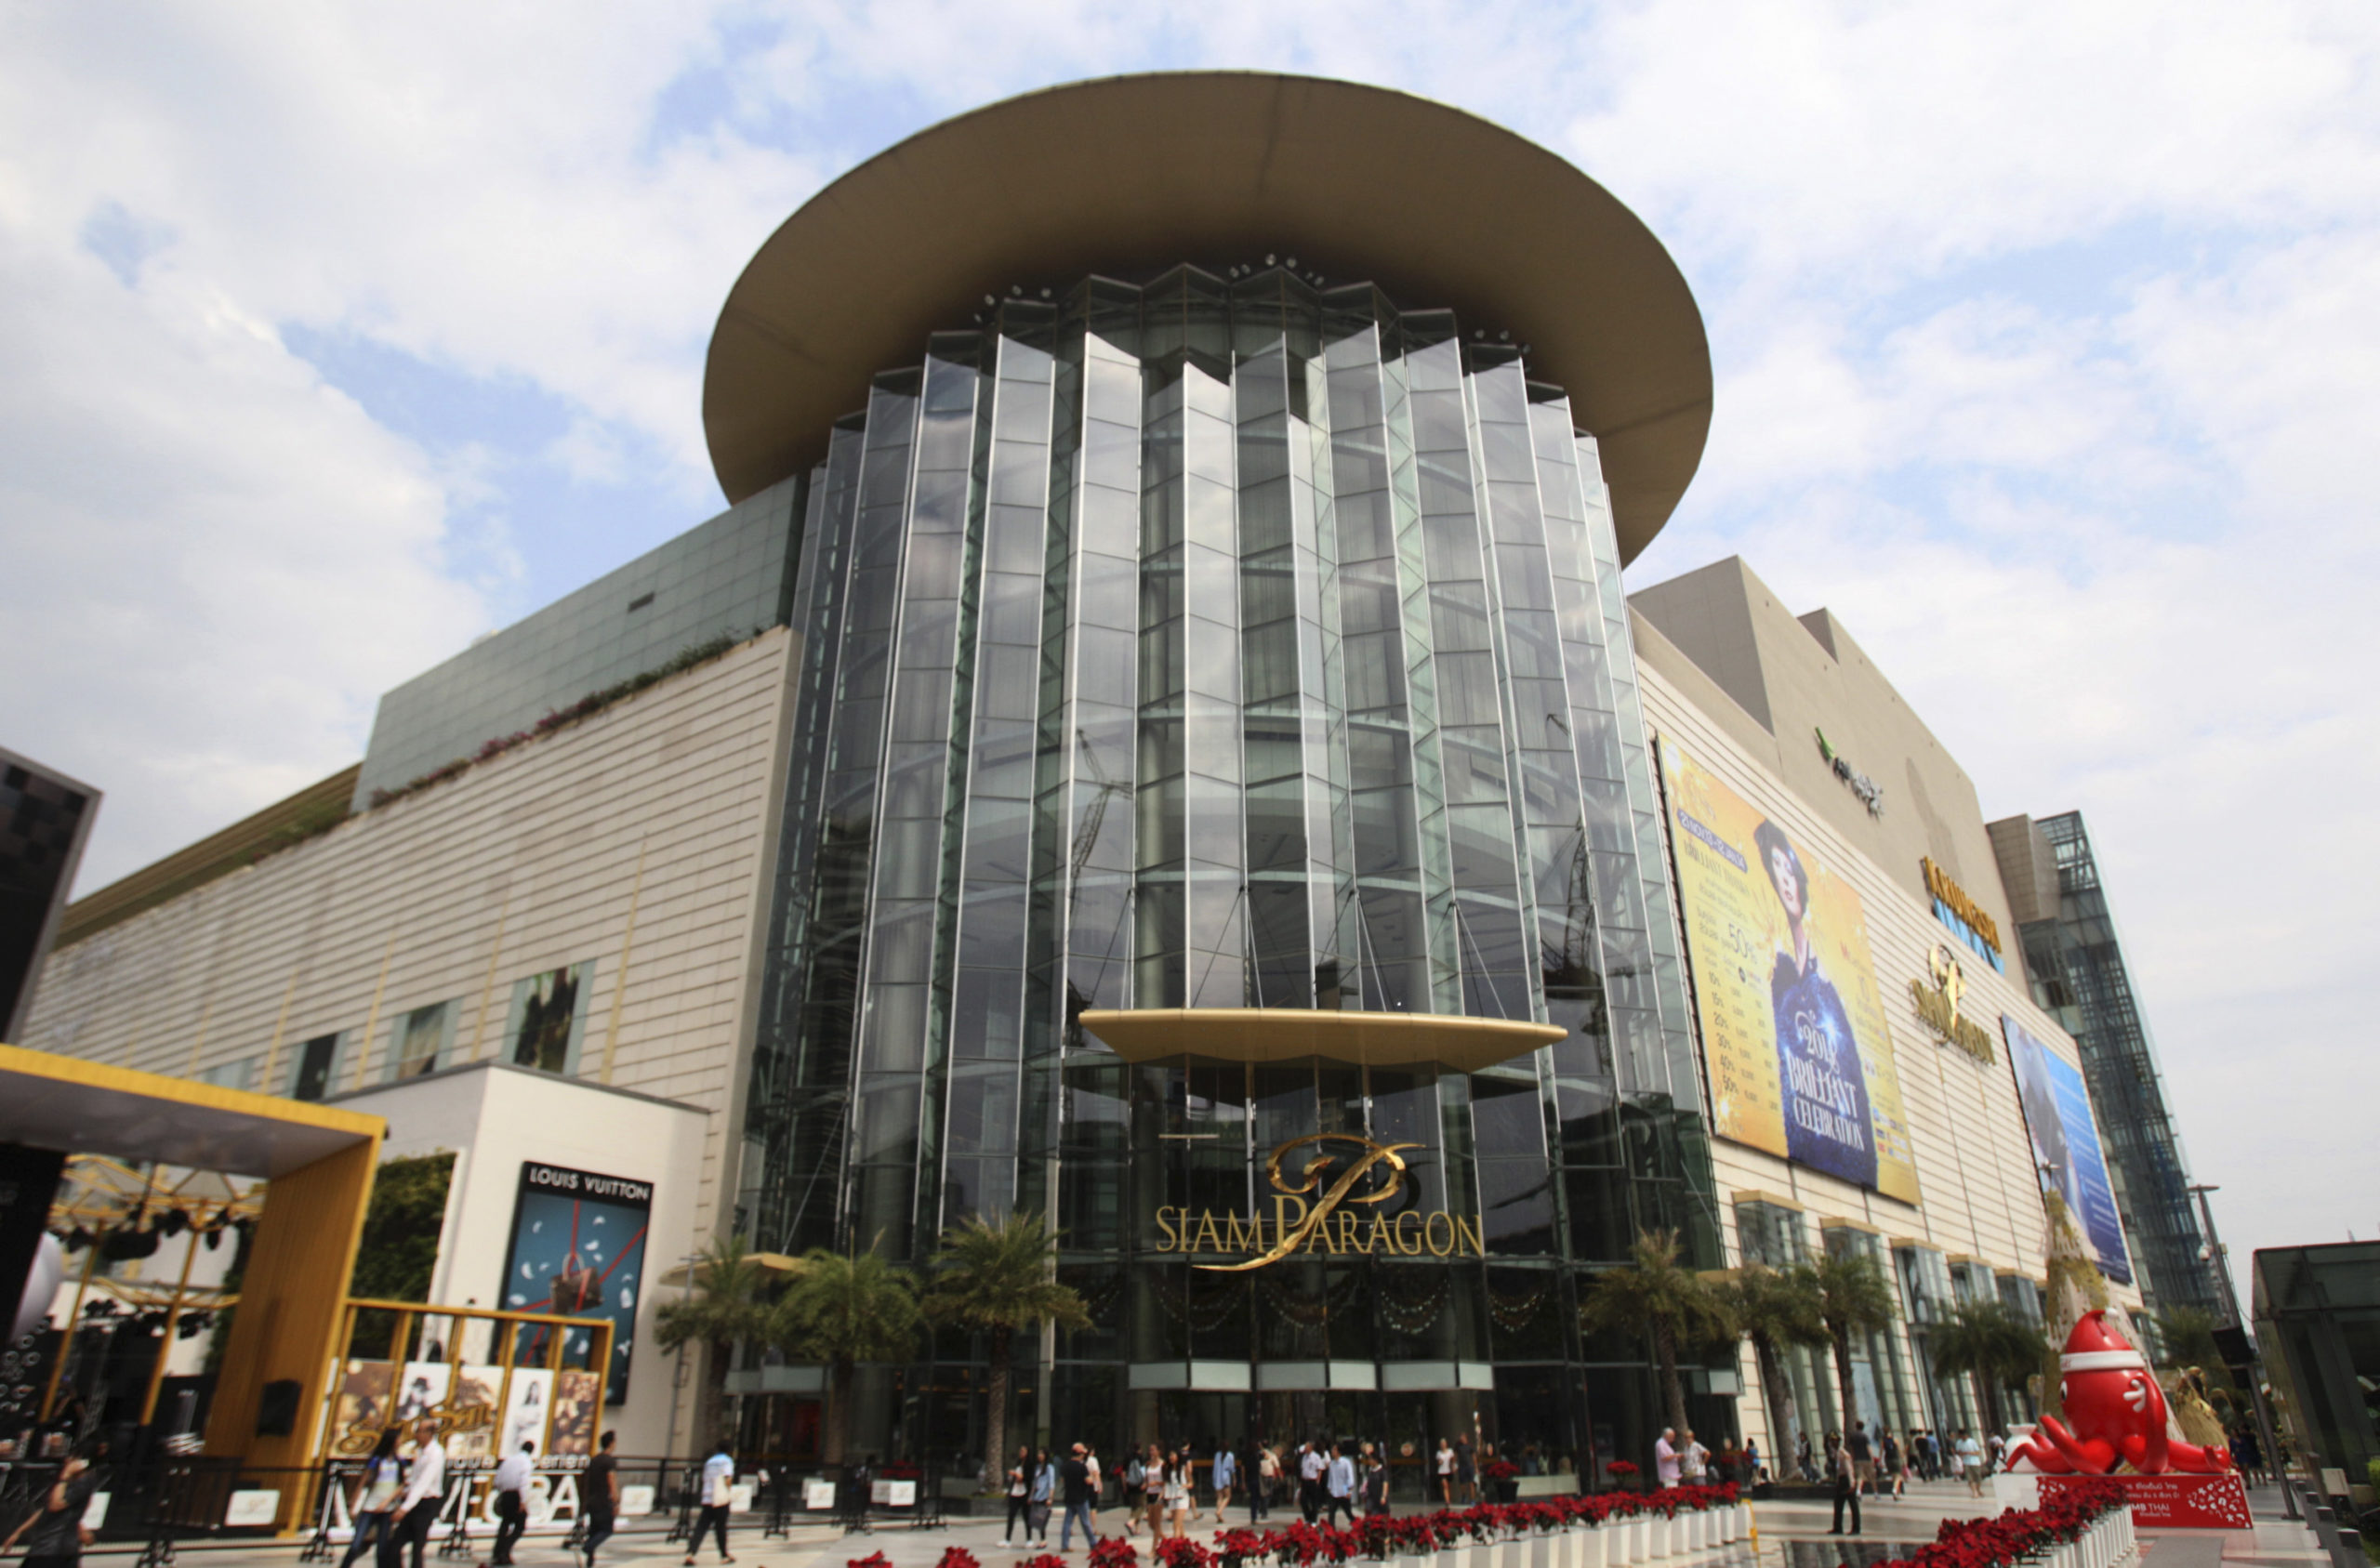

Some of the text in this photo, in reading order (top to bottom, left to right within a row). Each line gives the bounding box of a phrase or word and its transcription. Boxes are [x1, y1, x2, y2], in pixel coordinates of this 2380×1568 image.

[1787, 1050, 1857, 1118] BRILLIANT
[1793, 1097, 1864, 1152] CELEBRATION
[529, 1166, 650, 1201] LOUIS VUITTON
[1156, 1194, 1485, 1258] SIAM PARAGON
